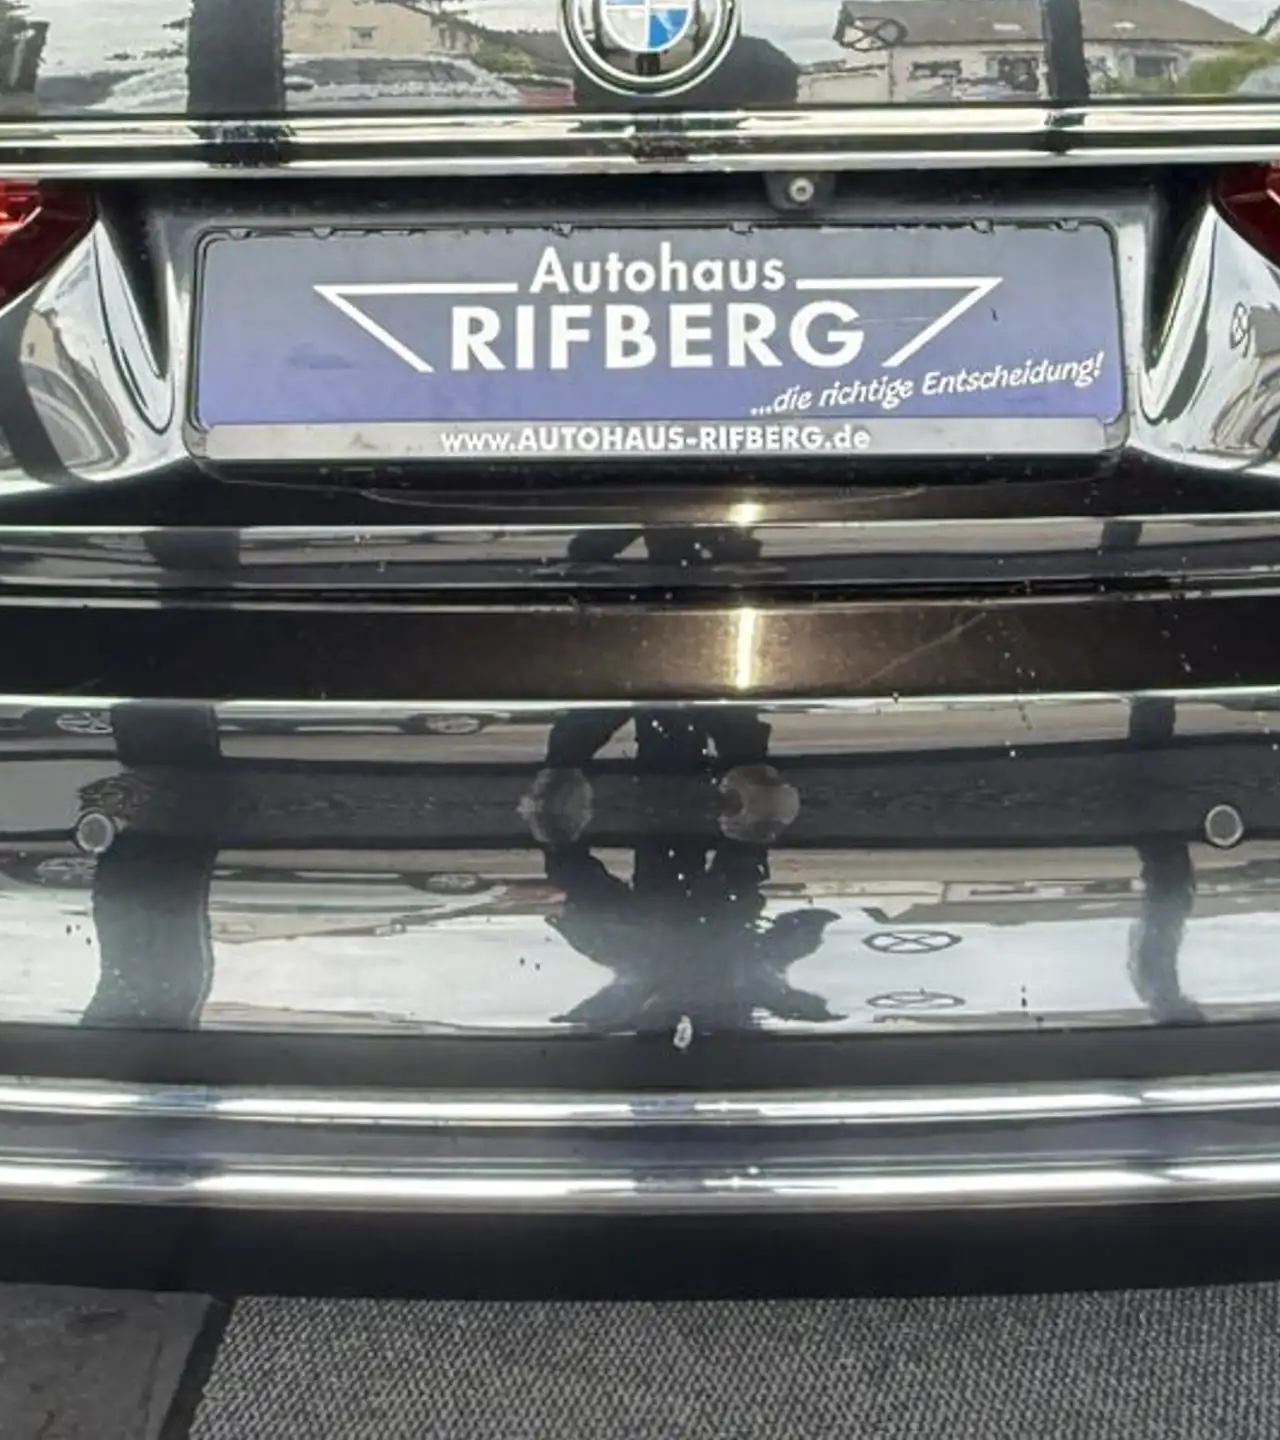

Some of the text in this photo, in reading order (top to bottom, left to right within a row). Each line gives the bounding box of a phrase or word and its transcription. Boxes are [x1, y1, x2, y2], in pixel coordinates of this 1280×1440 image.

[529, 241, 786, 294] Autohaus
[451, 301, 865, 371] RIFBERG
[818, 375, 914, 410] richtige
[921, 350, 1105, 396] Entscheidung!
[439, 424, 872, 453] www.AUTOHAUS-RIFBERG.de
